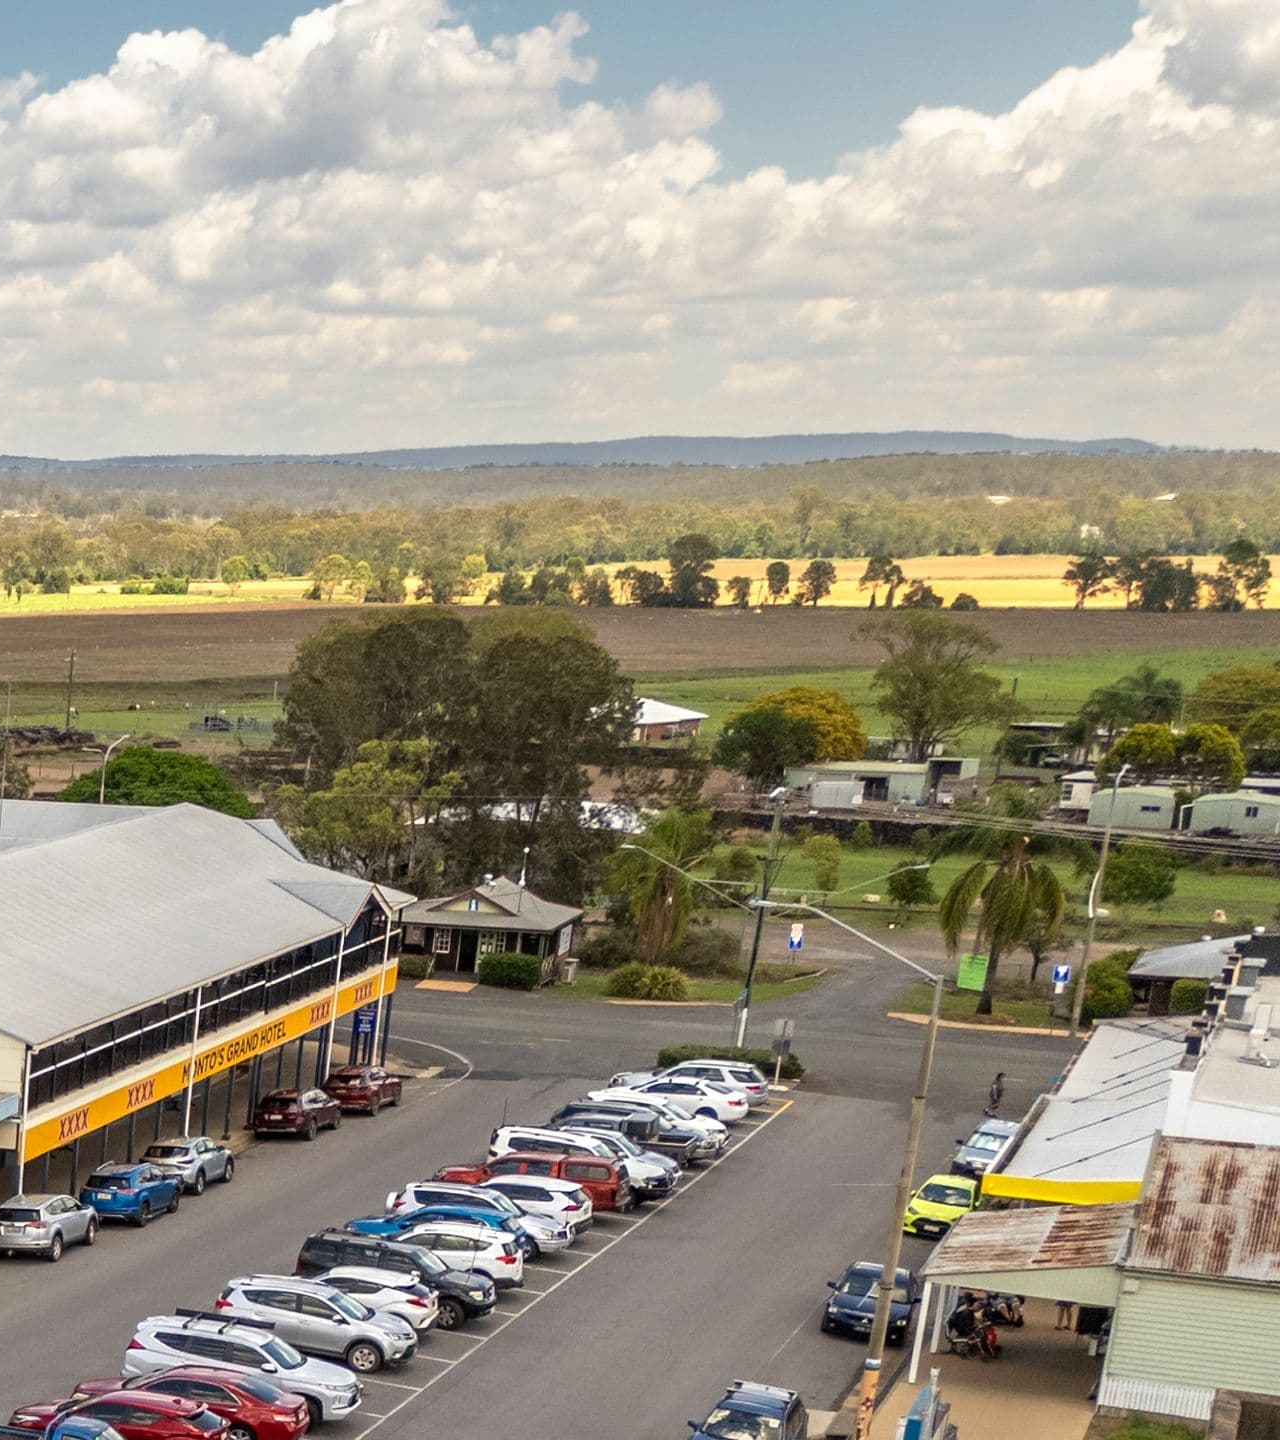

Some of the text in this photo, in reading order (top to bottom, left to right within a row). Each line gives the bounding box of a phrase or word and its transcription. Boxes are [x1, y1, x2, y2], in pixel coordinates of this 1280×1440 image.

[354, 981, 374, 1004] XXXX
[309, 1000, 332, 1025] XXXX
[226, 1032, 260, 1062] GRAND
[260, 1021, 287, 1049] HOTEL
[126, 1078, 156, 1110] XXXX
[58, 1108, 90, 1141] XXXX
